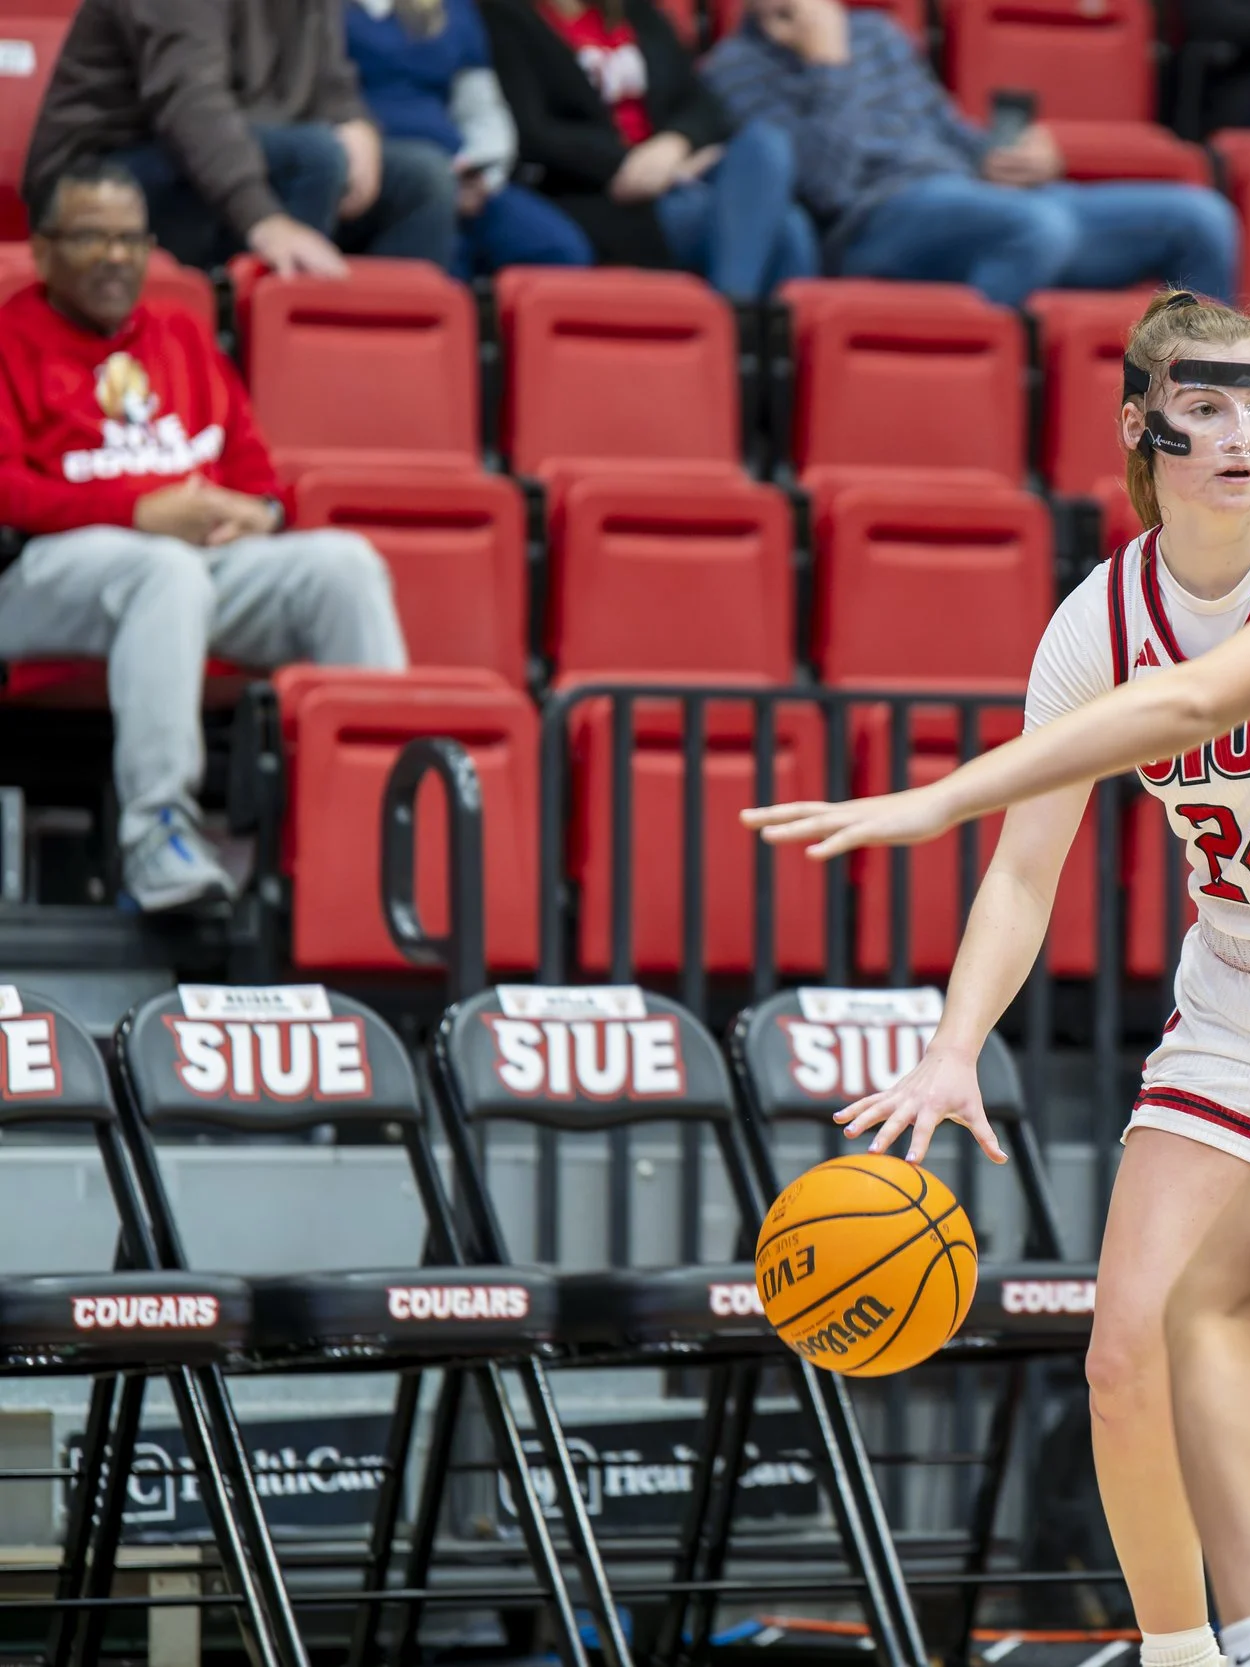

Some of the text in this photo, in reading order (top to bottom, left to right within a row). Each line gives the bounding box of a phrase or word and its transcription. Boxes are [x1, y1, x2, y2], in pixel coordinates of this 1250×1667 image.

[1160, 438, 1187, 450] MUELLER
[172, 1019, 369, 1097] SIUE
[491, 1018, 683, 1096] SIUE
[786, 1021, 938, 1097] SIU
[73, 1296, 218, 1328] COUGARS
[388, 1287, 529, 1319] COUGARS
[794, 1294, 896, 1357] Wilso
